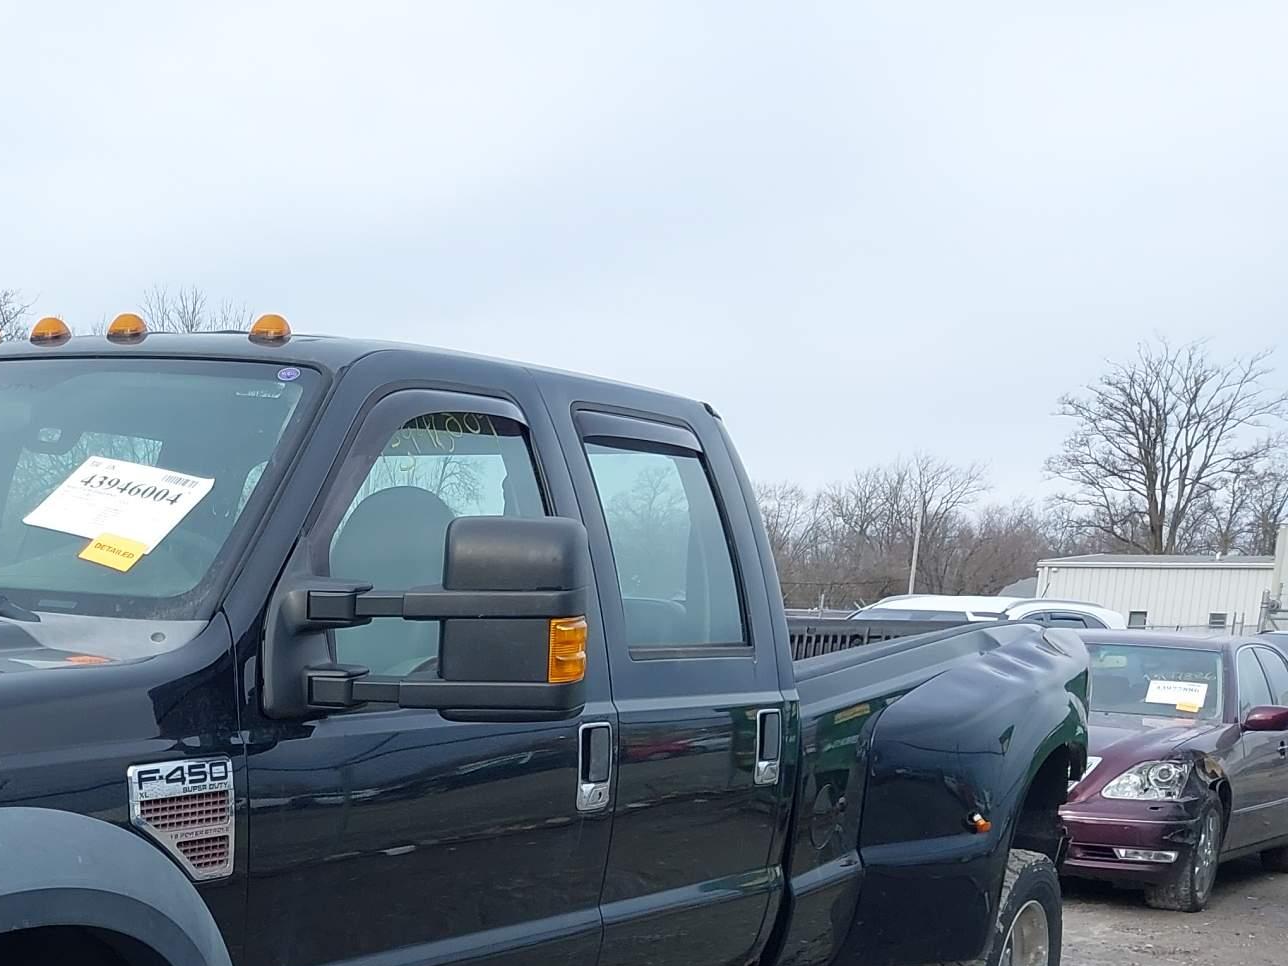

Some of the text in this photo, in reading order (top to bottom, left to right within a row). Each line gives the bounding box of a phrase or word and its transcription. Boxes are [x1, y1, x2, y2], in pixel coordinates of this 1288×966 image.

[80, 473, 183, 505] 43946004
[94, 542, 135, 560] DETAILED
[137, 761, 228, 790] F-450
[182, 782, 229, 793] SUPER DUTY
